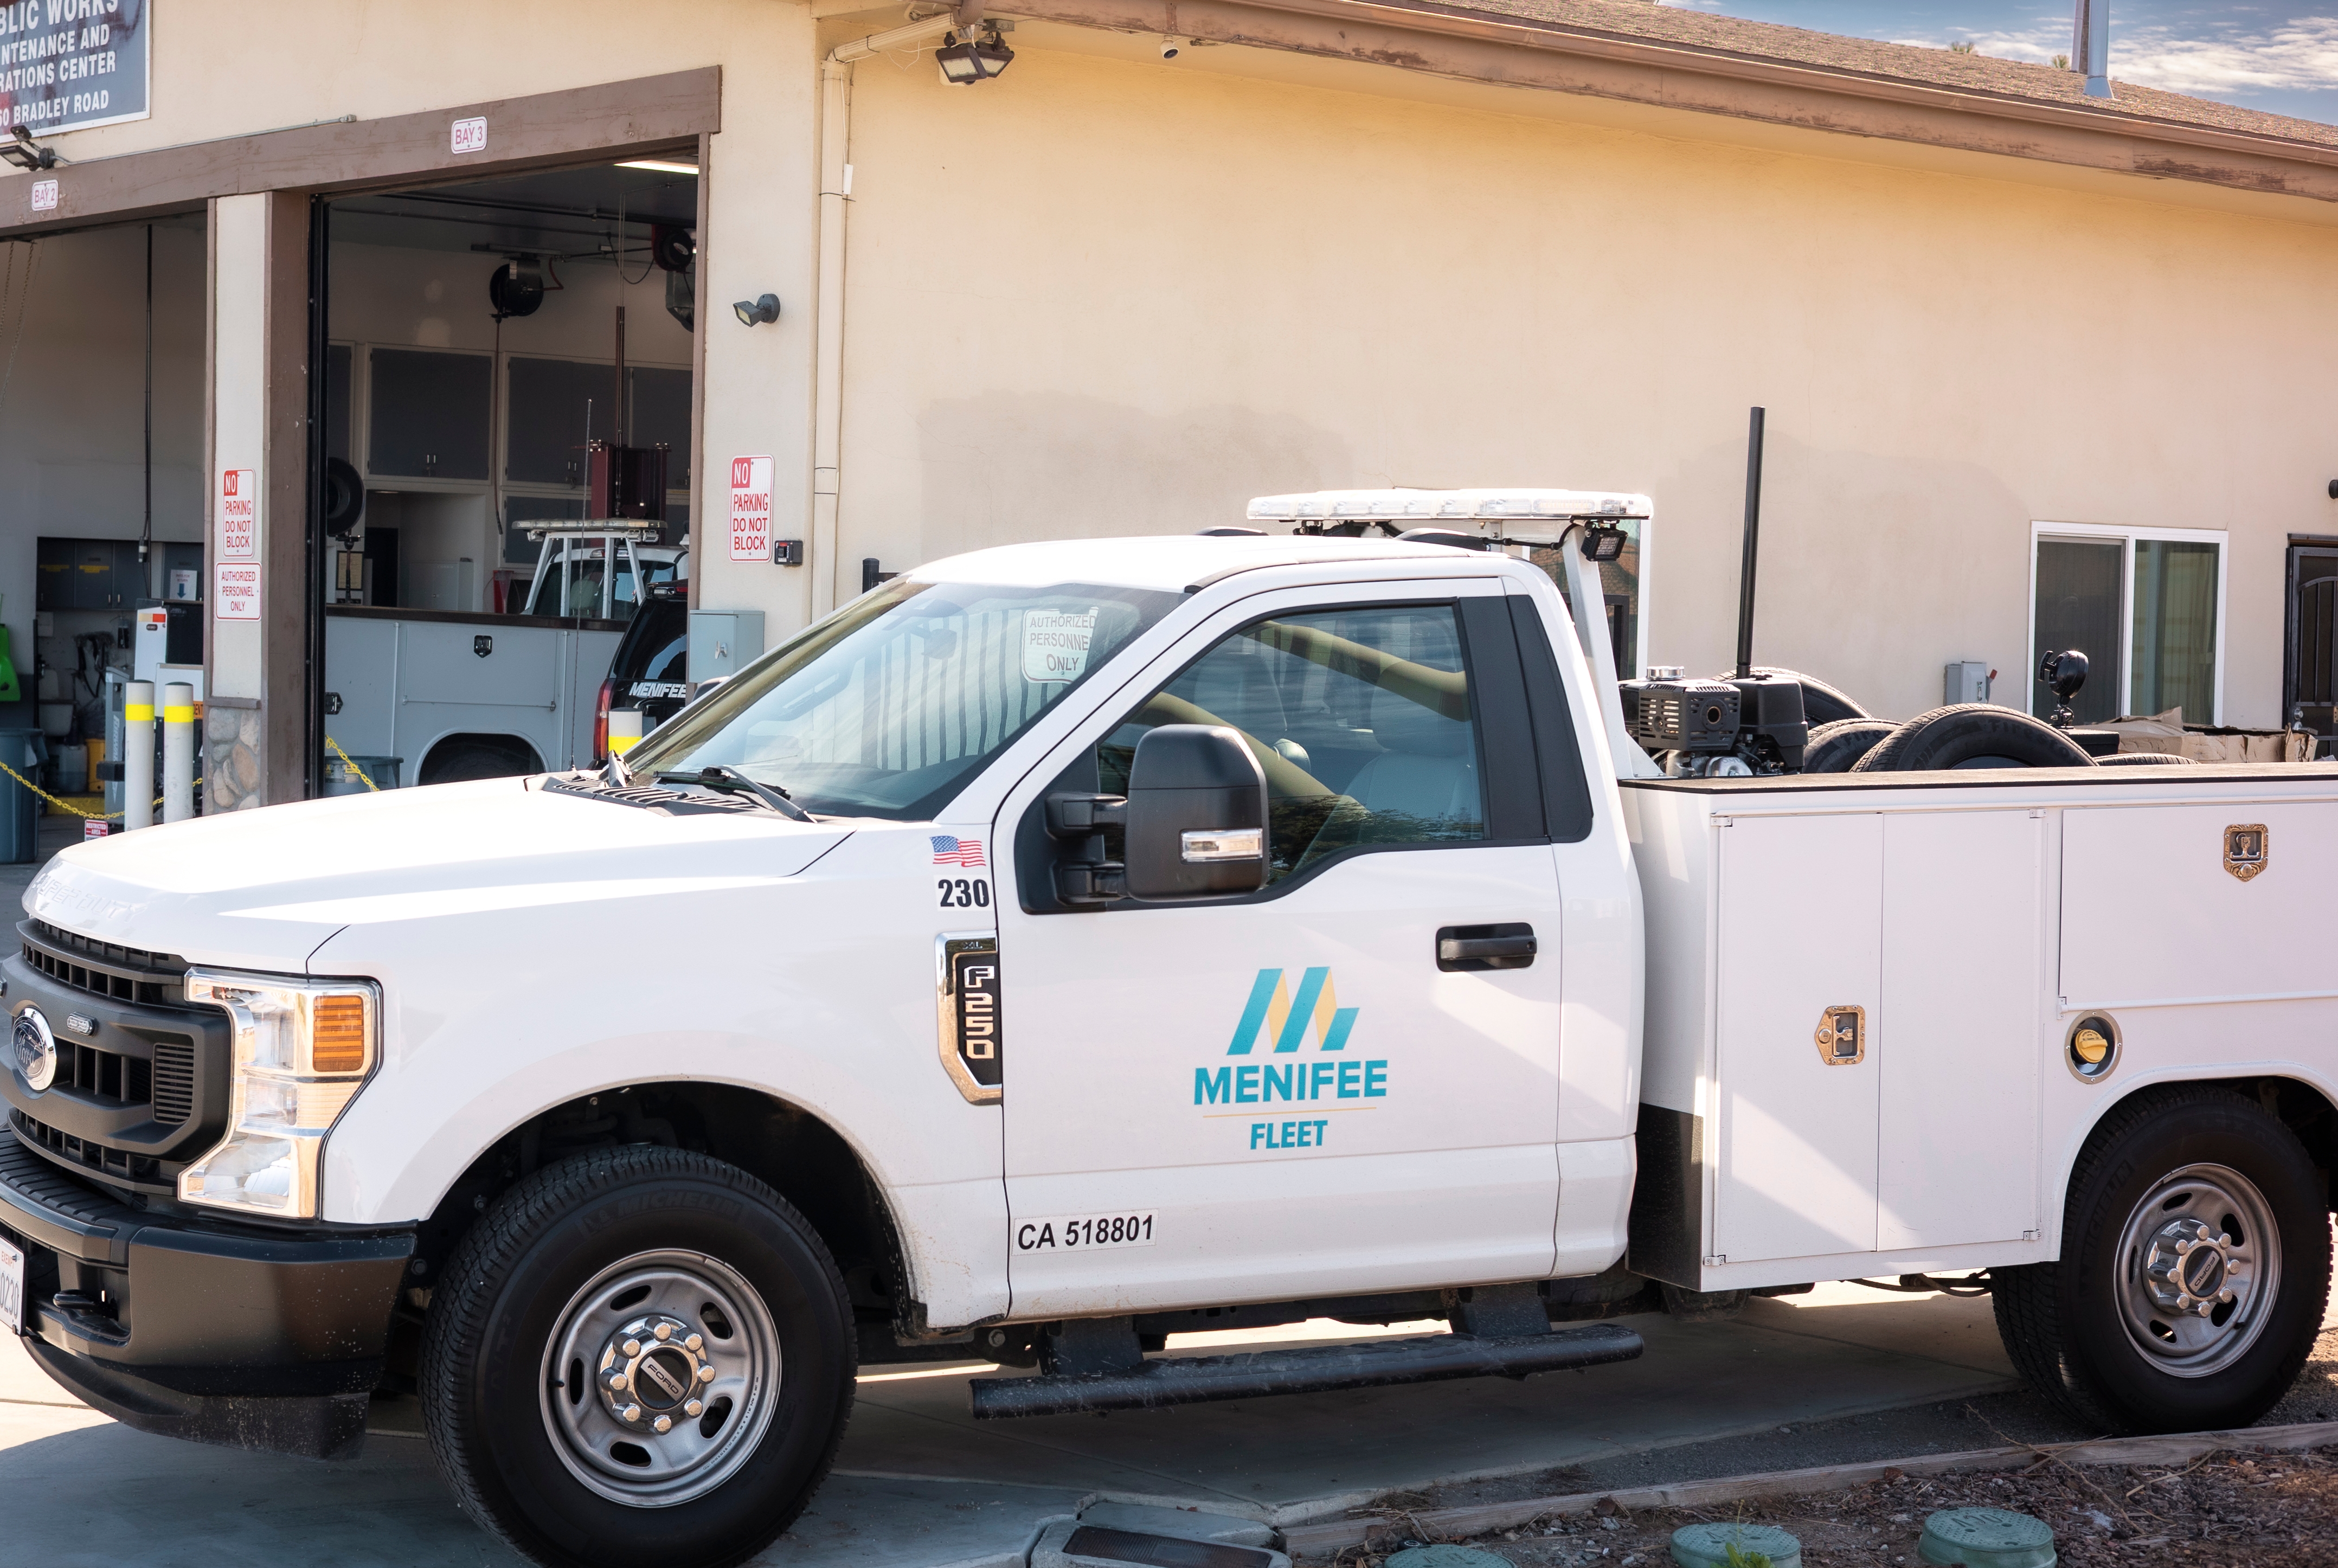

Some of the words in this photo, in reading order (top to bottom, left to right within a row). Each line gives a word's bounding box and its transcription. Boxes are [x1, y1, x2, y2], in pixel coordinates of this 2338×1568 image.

[2, 30, 75, 66] NTENANCE
[80, 24, 110, 49] AND
[60, 51, 115, 81] CENTER
[14, 97, 69, 124] BRADLEY
[74, 89, 109, 113] ROAD
[455, 127, 475, 145] BAY
[478, 126, 483, 142] 3
[35, 188, 49, 203] BAY
[51, 188, 55, 201] 2
[734, 462, 749, 484] NO
[225, 474, 236, 493] NO
[226, 500, 251, 516] PARKING
[733, 493, 768, 512] PARKING
[226, 520, 235, 533] DO
[237, 520, 251, 532] NOT
[733, 518, 746, 532] DO
[749, 517, 768, 532] NOT
[227, 535, 250, 548] BLOCK
[734, 536, 766, 550] BLOCK
[221, 571, 255, 582] AUTHORIZED
[222, 586, 254, 596] PERSONNEL
[230, 601, 246, 611] ONLY
[1030, 615, 1096, 629] AUTHORIZED
[1030, 632, 1090, 651] PERSONNE
[1046, 653, 1080, 671] ONLY
[628, 682, 686, 698] MENIFEE
[937, 879, 990, 908] 230
[75, 893, 148, 923] DUTY
[962, 941, 983, 950] XL
[1194, 1059, 1388, 1105] MENIFEE
[1250, 1120, 1328, 1150] FLEET
[1018, 1222, 1056, 1250] CA
[1065, 1214, 1153, 1246] 518801
[2194, 1256, 2215, 1287] FORD
[647, 1364, 679, 1395] FORD
